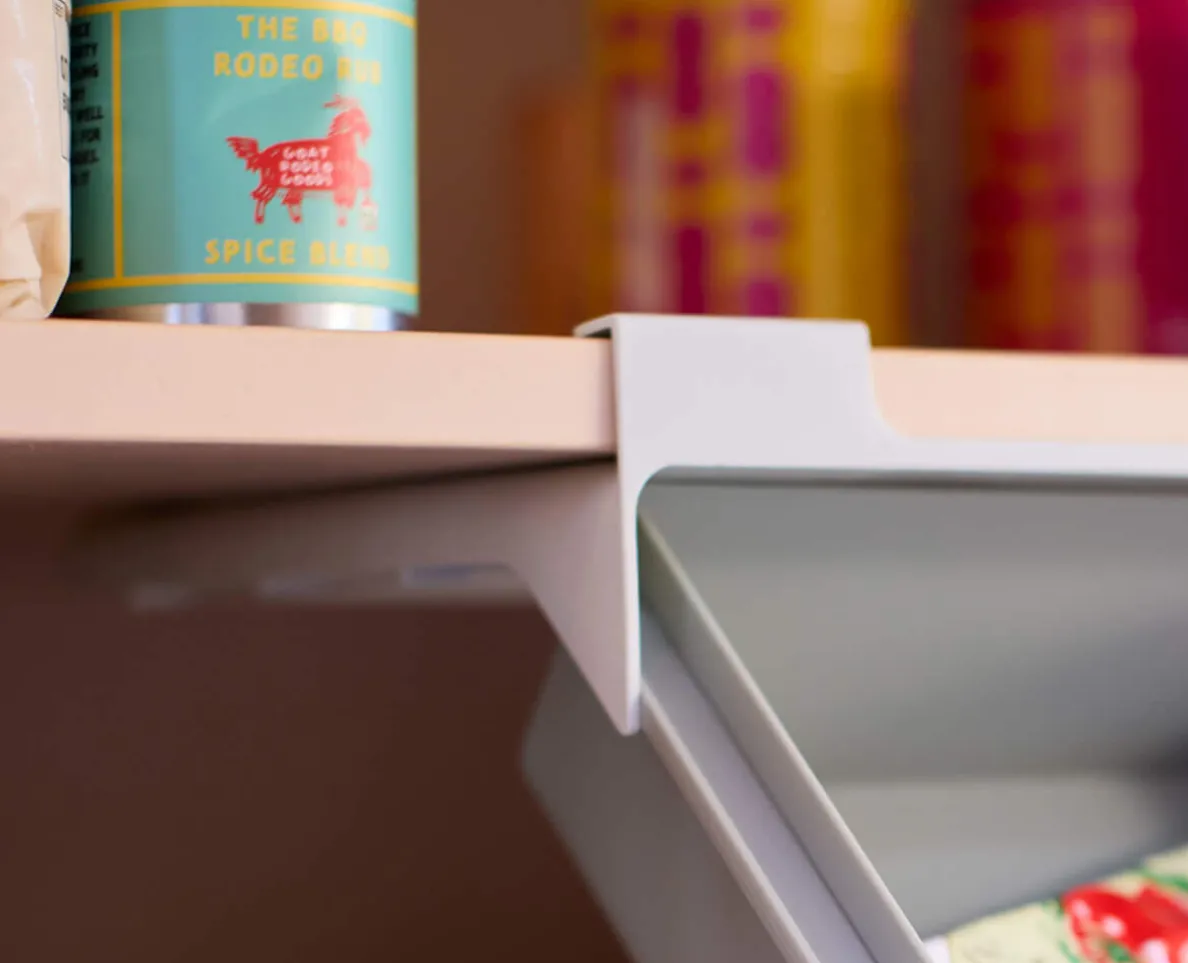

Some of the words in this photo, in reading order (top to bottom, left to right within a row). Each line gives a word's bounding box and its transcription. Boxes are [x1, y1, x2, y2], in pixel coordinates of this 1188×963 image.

[236, 14, 299, 41] THE
[312, 17, 367, 49] BBQ
[213, 51, 324, 80] RODEO
[282, 145, 331, 160] GOAT
[204, 238, 296, 265] SPICE
[308, 240, 391, 271] BLEND
